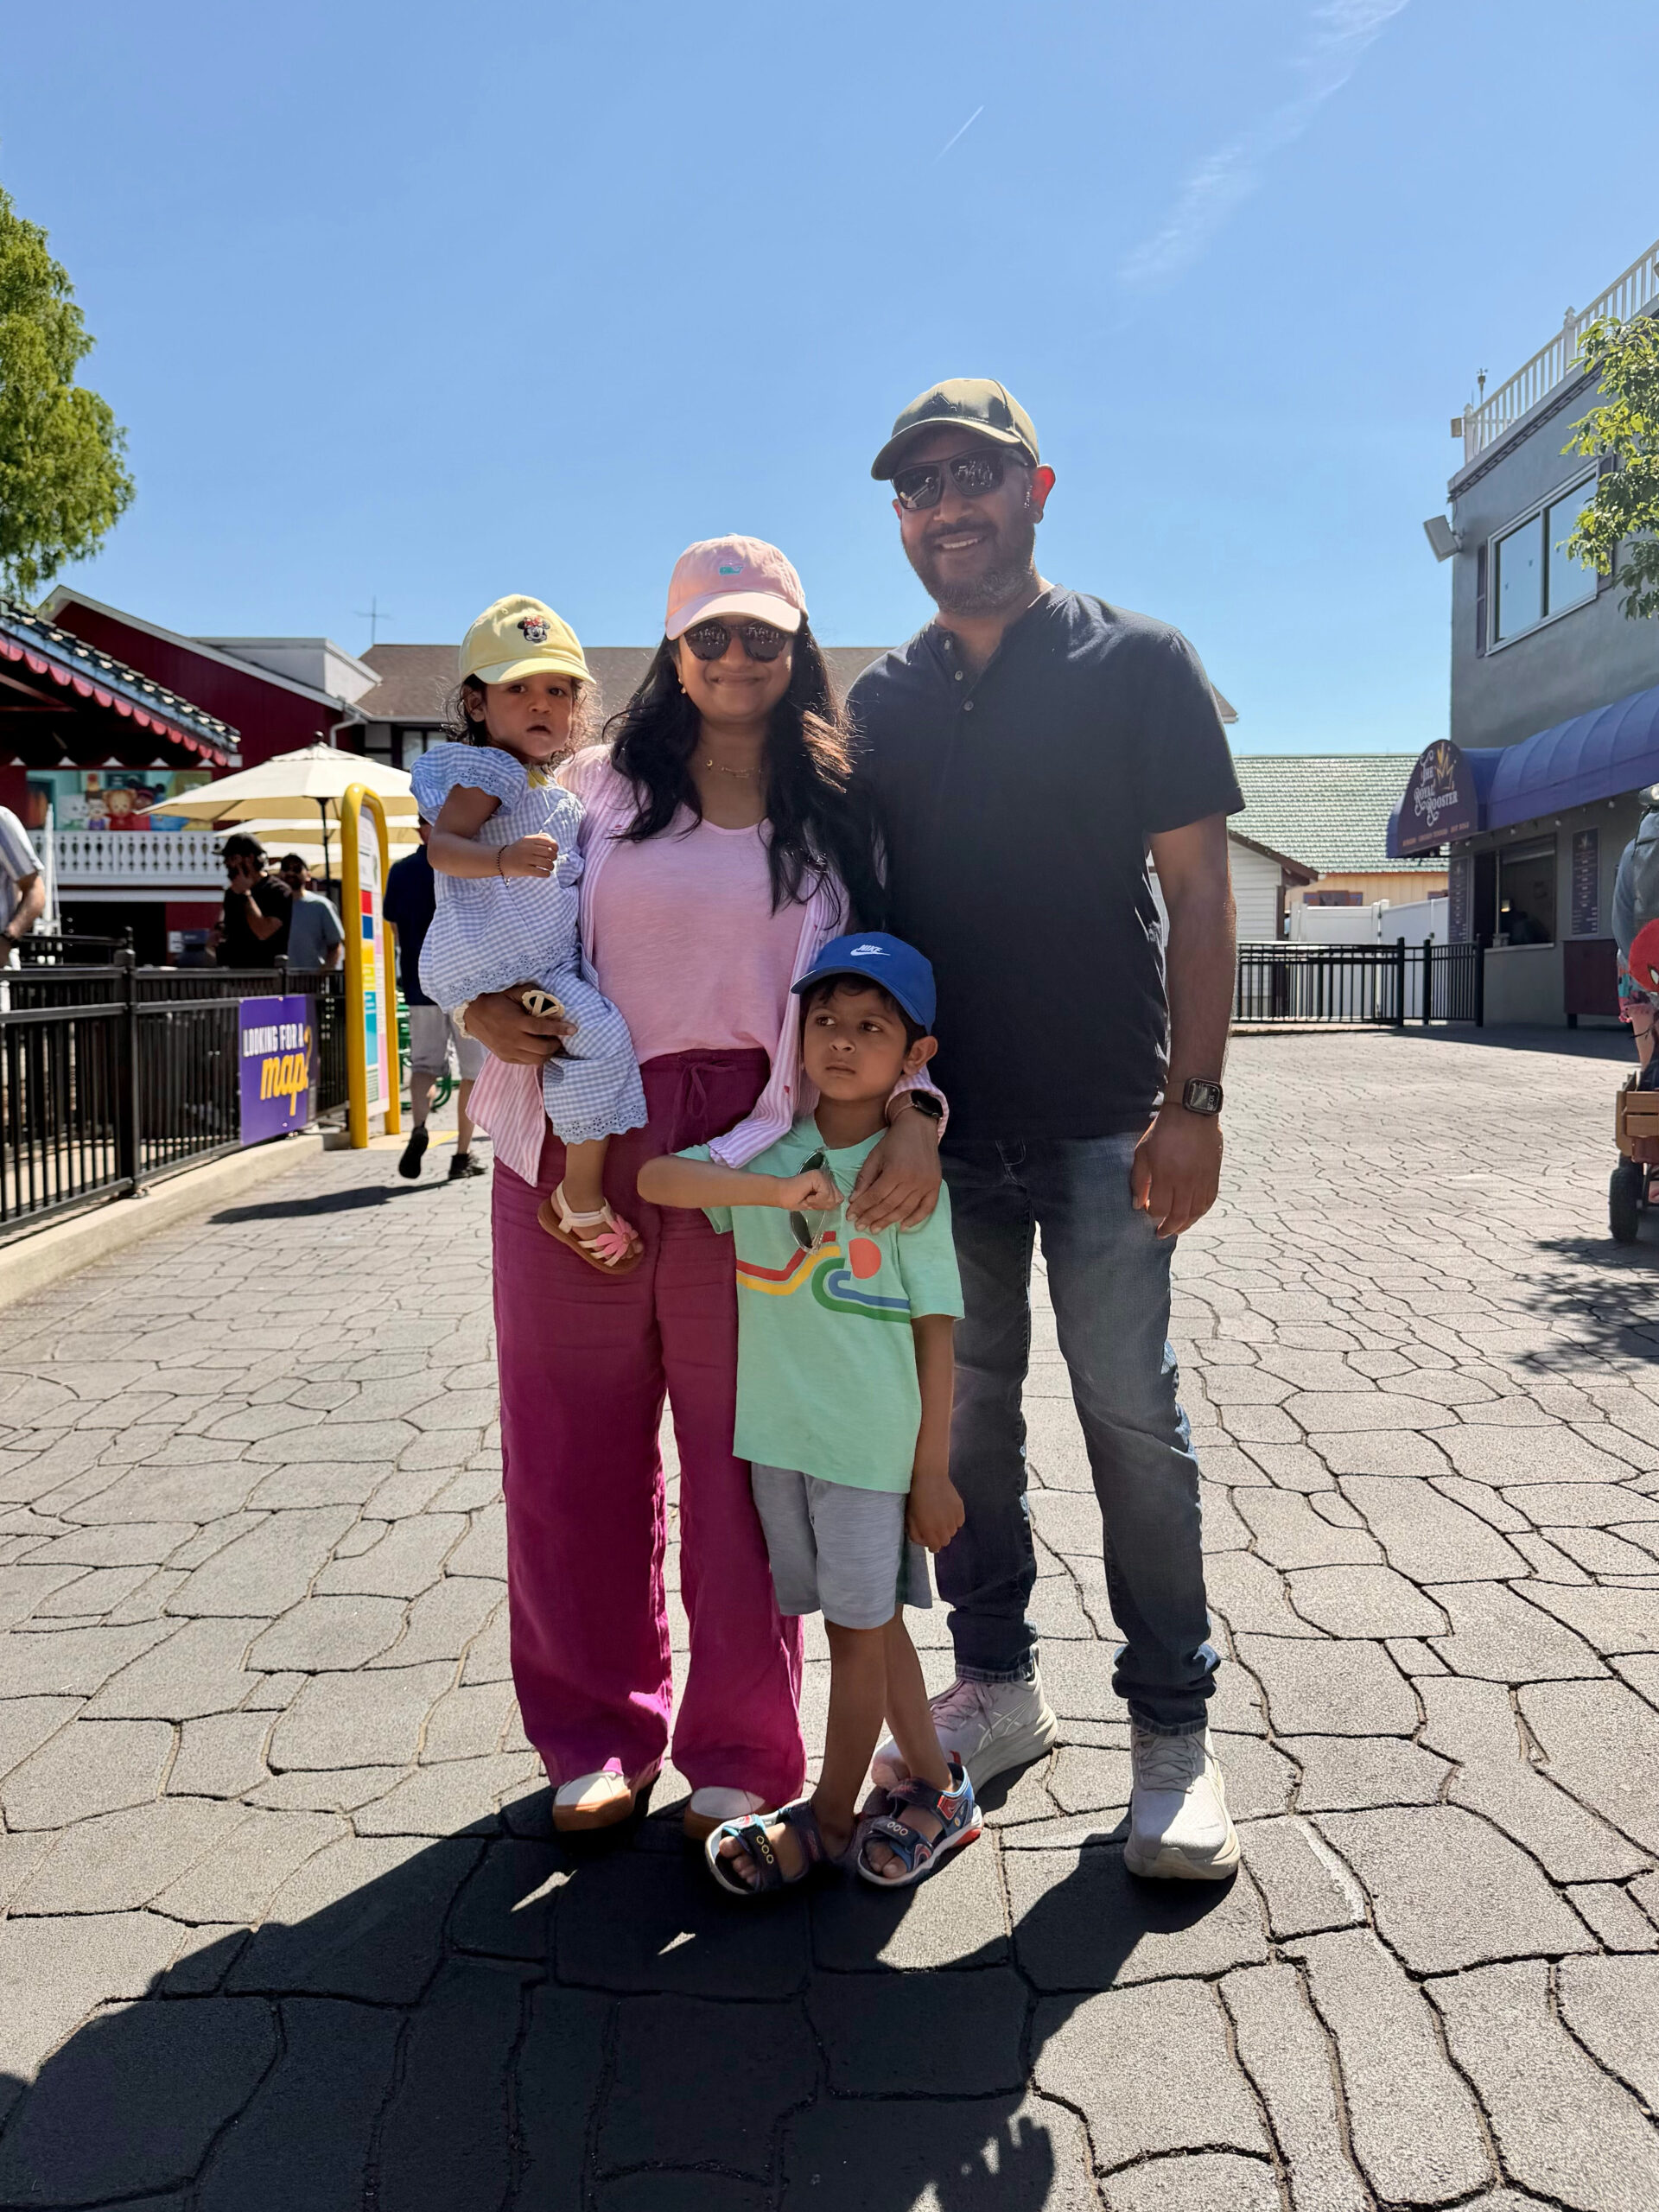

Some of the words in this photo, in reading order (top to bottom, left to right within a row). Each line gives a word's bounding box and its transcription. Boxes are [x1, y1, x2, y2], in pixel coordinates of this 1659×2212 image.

[1420, 750, 1433, 786] THE
[1414, 785, 1435, 816] ROYAL
[1424, 791, 1458, 827] ROOSTER
[243, 1026, 277, 1057] LOOKING
[279, 1023, 297, 1050] FOR
[298, 1022, 303, 1048] A
